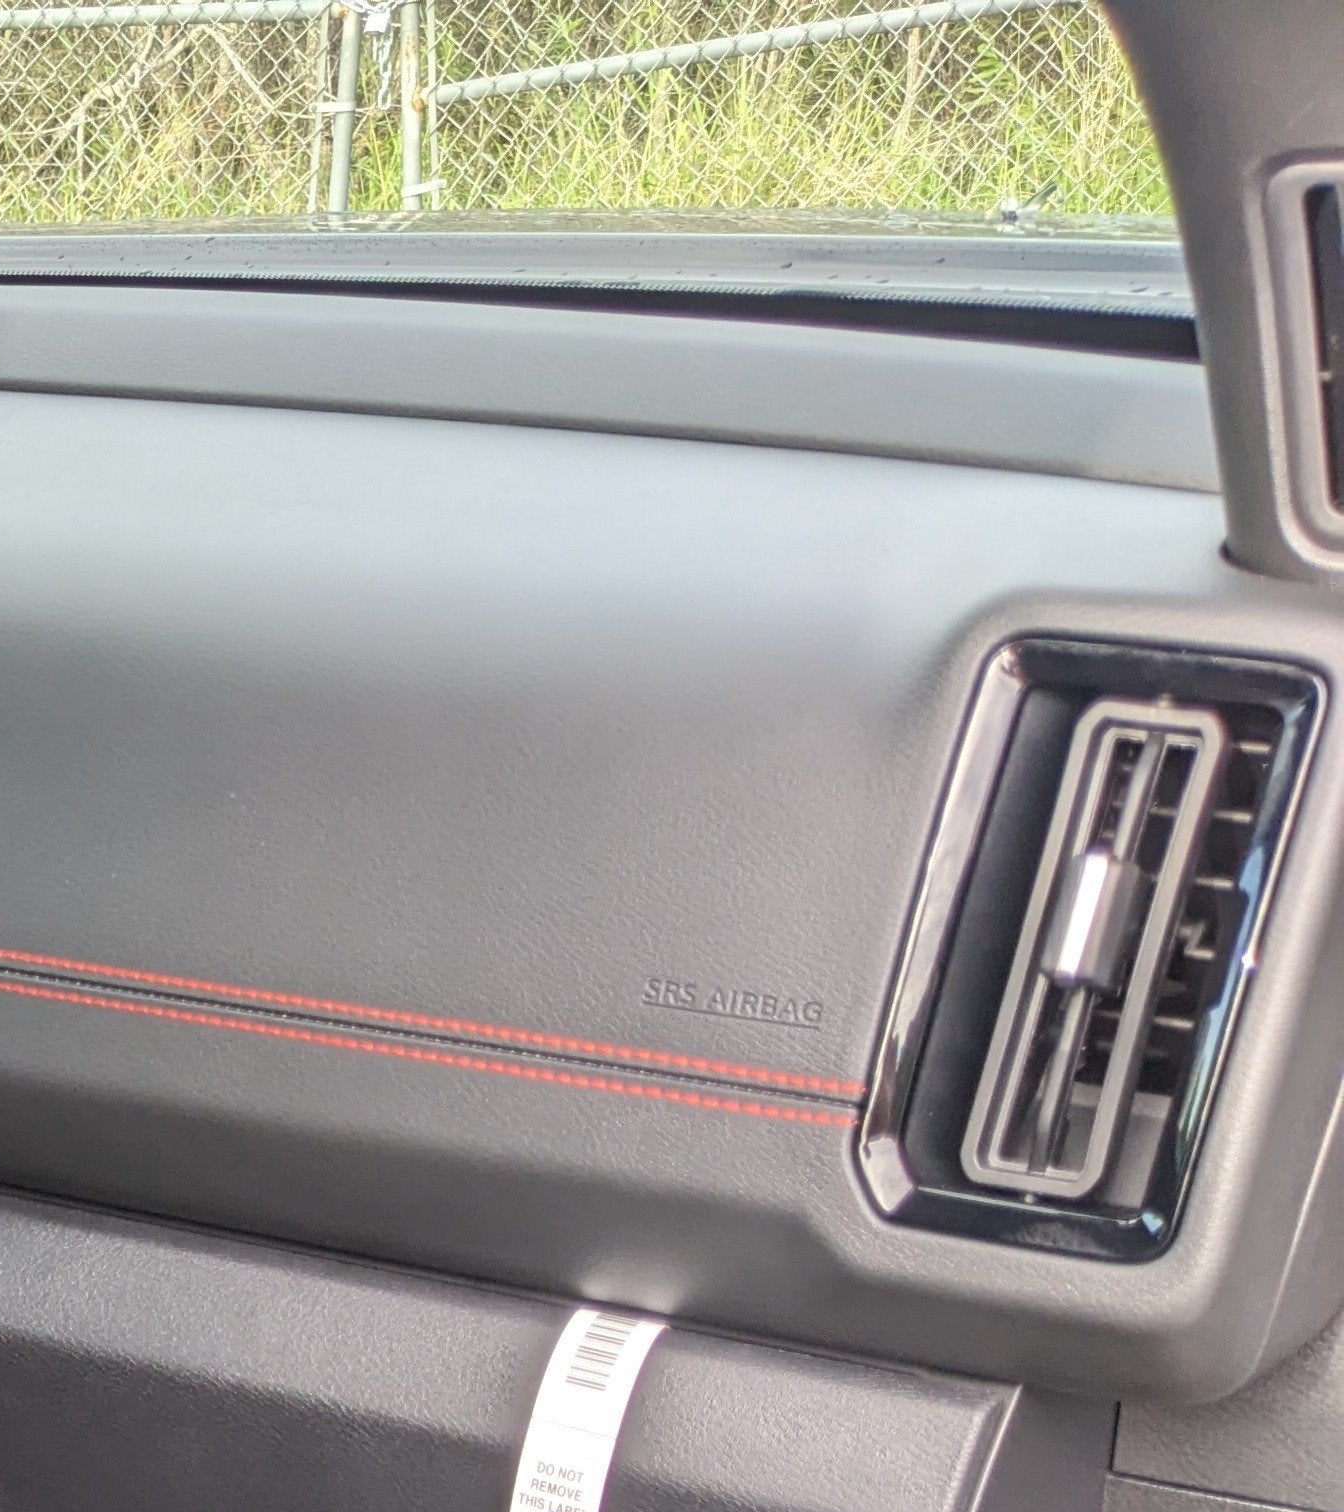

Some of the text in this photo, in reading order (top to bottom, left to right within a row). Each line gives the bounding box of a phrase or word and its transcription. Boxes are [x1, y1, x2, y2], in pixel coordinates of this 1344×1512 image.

[642, 977, 823, 1024] SRS AIRBAG
[536, 1461, 584, 1483] DO NOT
[519, 1492, 545, 1510] THIS
[530, 1478, 582, 1502] REMOVE
